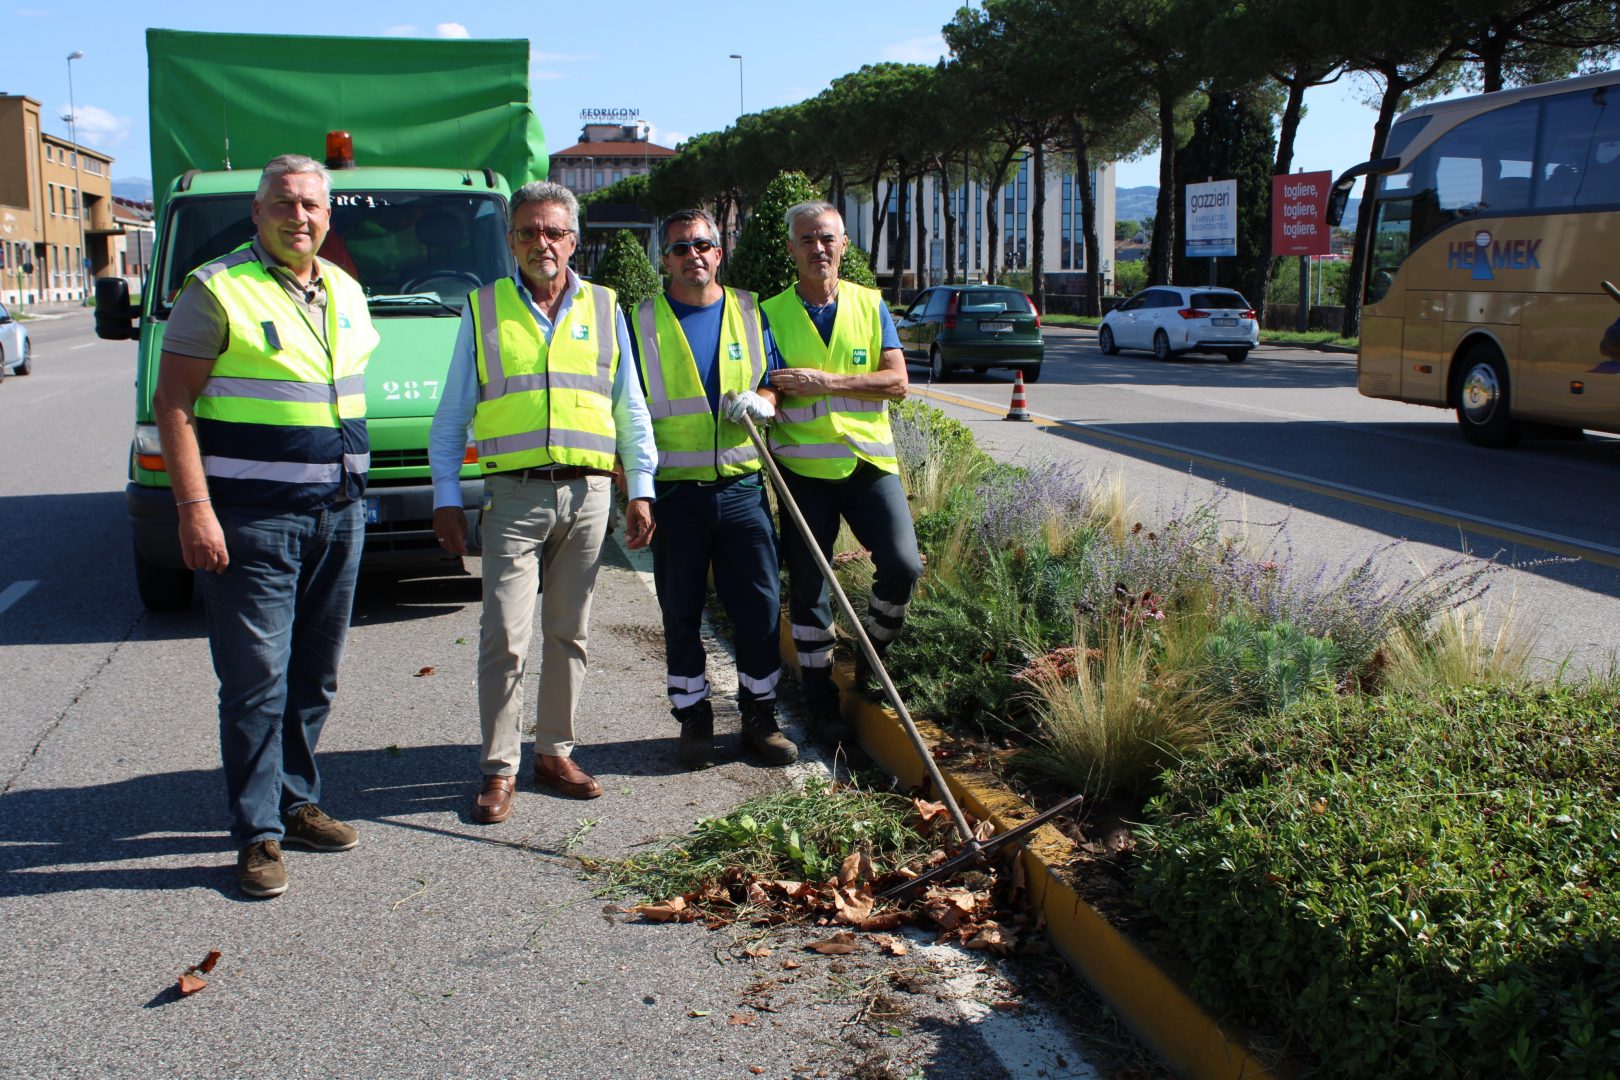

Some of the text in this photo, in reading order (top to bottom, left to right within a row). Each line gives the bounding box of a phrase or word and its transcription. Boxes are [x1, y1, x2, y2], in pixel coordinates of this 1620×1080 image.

[581, 108, 640, 117] FEDRIGONI
[1190, 187, 1230, 213] gazzieri
[1283, 183, 1317, 200] togliere,
[1283, 201, 1318, 220] togliere,
[1283, 221, 1317, 239] togliere.
[1447, 230, 1543, 281] HERMEK
[382, 380, 440, 401] 287
